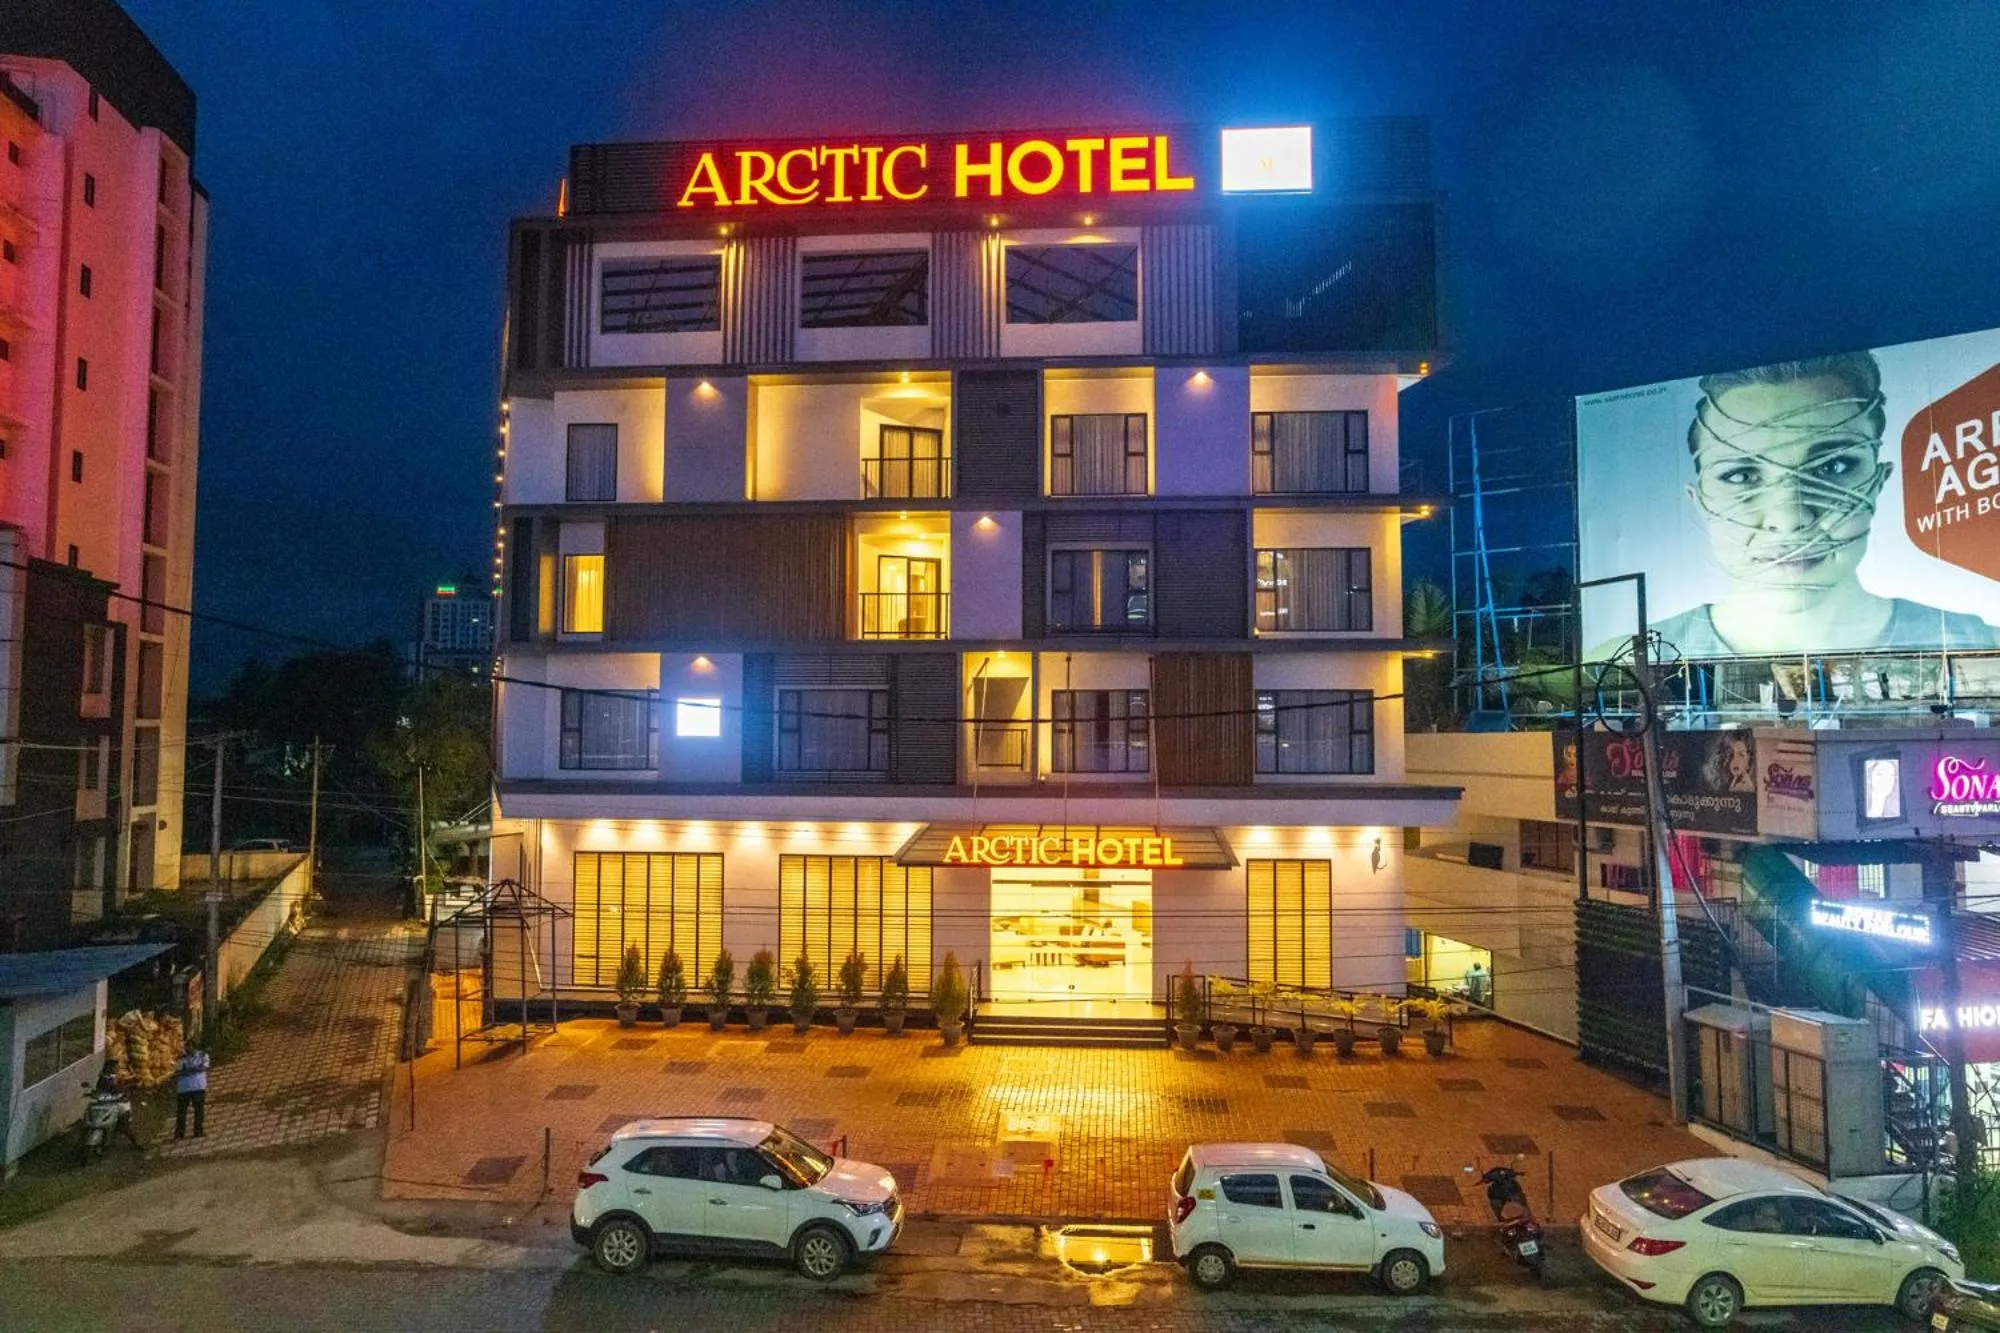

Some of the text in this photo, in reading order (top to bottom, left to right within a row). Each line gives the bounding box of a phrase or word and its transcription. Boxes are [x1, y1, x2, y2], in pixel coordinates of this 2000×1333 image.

[677, 136, 1194, 206] ARCTIC HOTEL
[1917, 502, 1969, 533] WITH
[943, 835, 1183, 865] ARCTIC HOTEL
[1920, 1006, 2000, 1029] FAHIO
